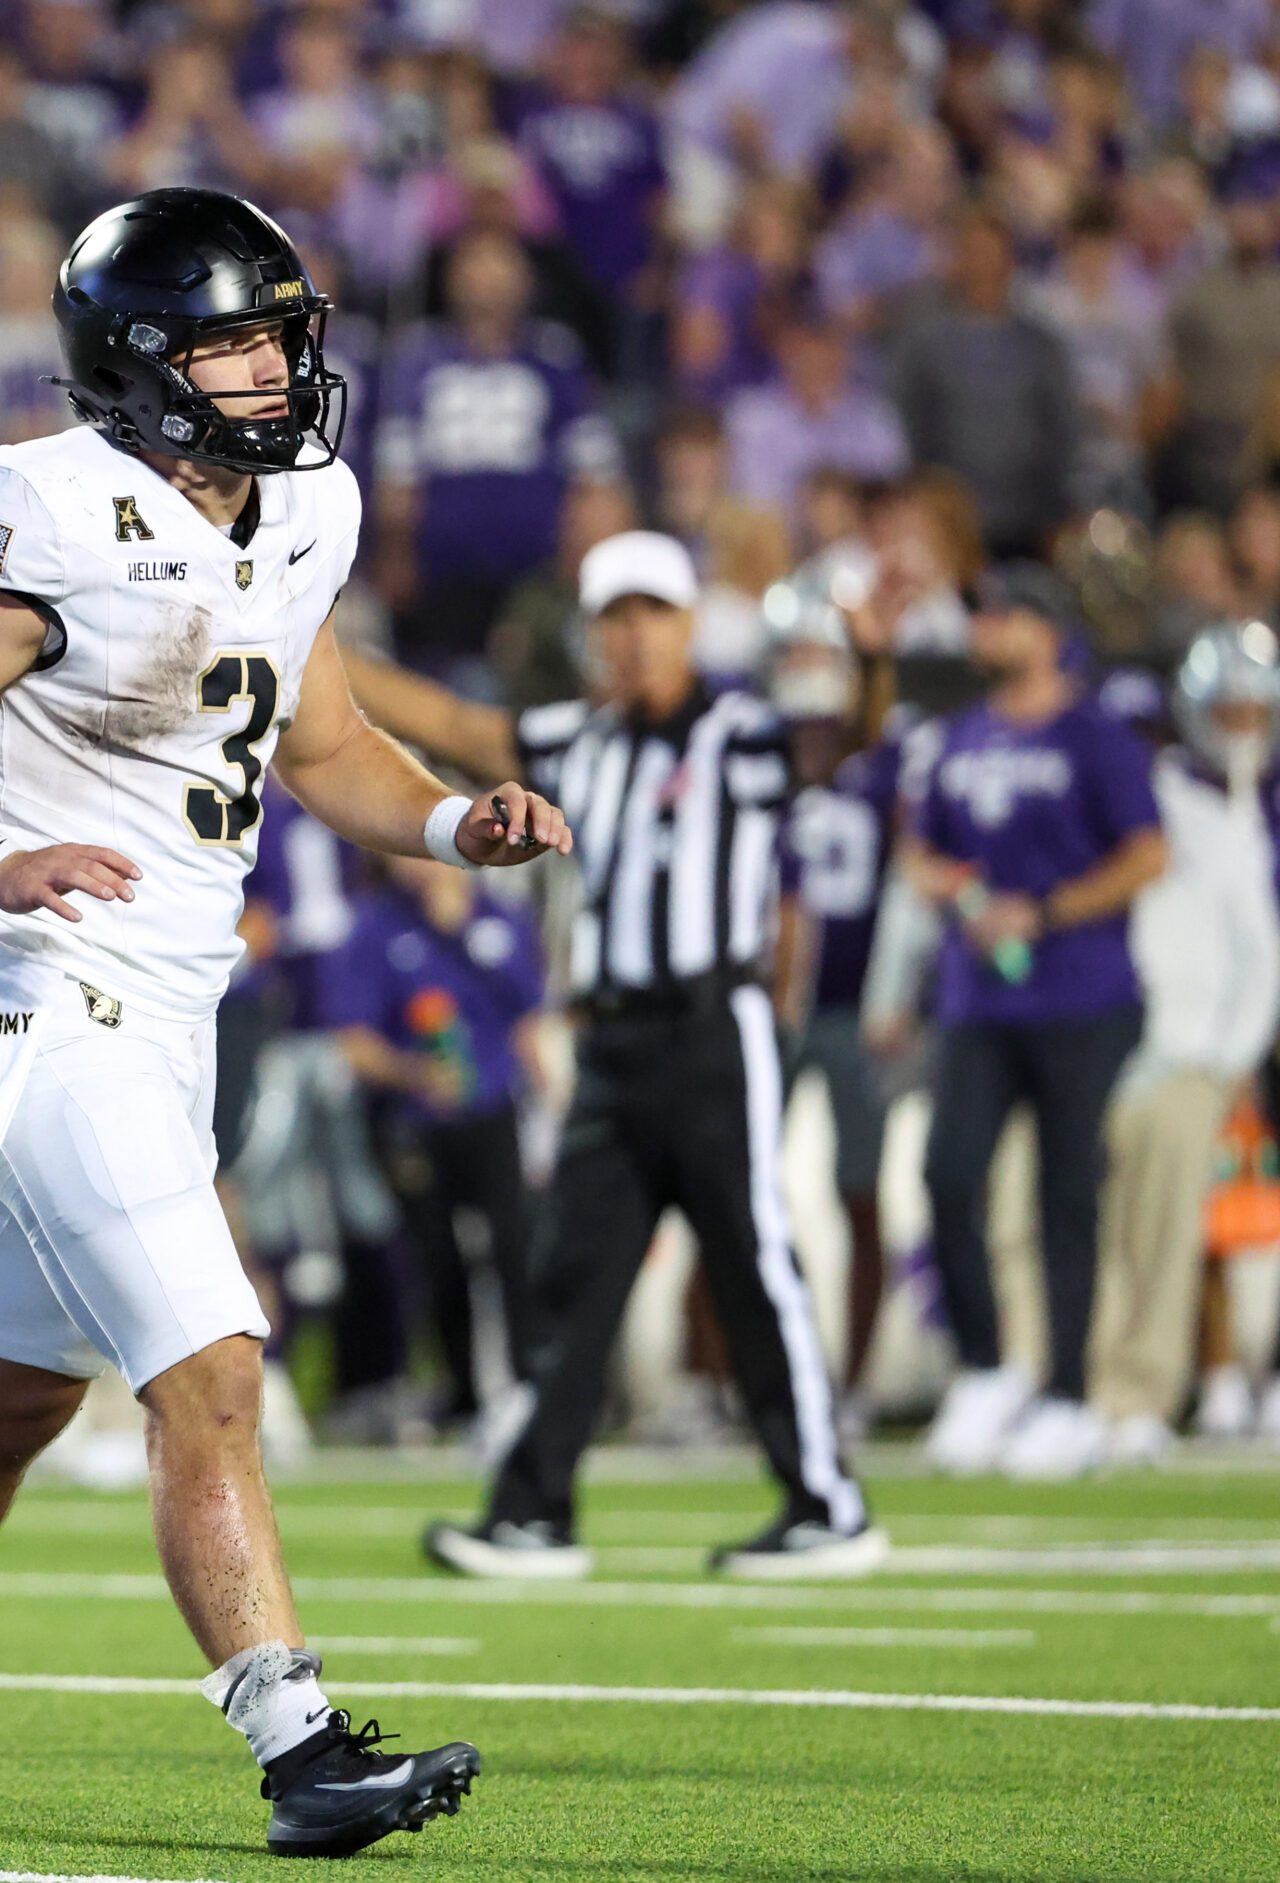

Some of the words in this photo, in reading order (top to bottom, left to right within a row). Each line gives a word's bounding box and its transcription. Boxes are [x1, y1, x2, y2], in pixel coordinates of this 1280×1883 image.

[274, 280, 303, 300] ARMY
[112, 496, 155, 542] A
[128, 561, 187, 581] HELLUMS
[183, 652, 280, 847] 3
